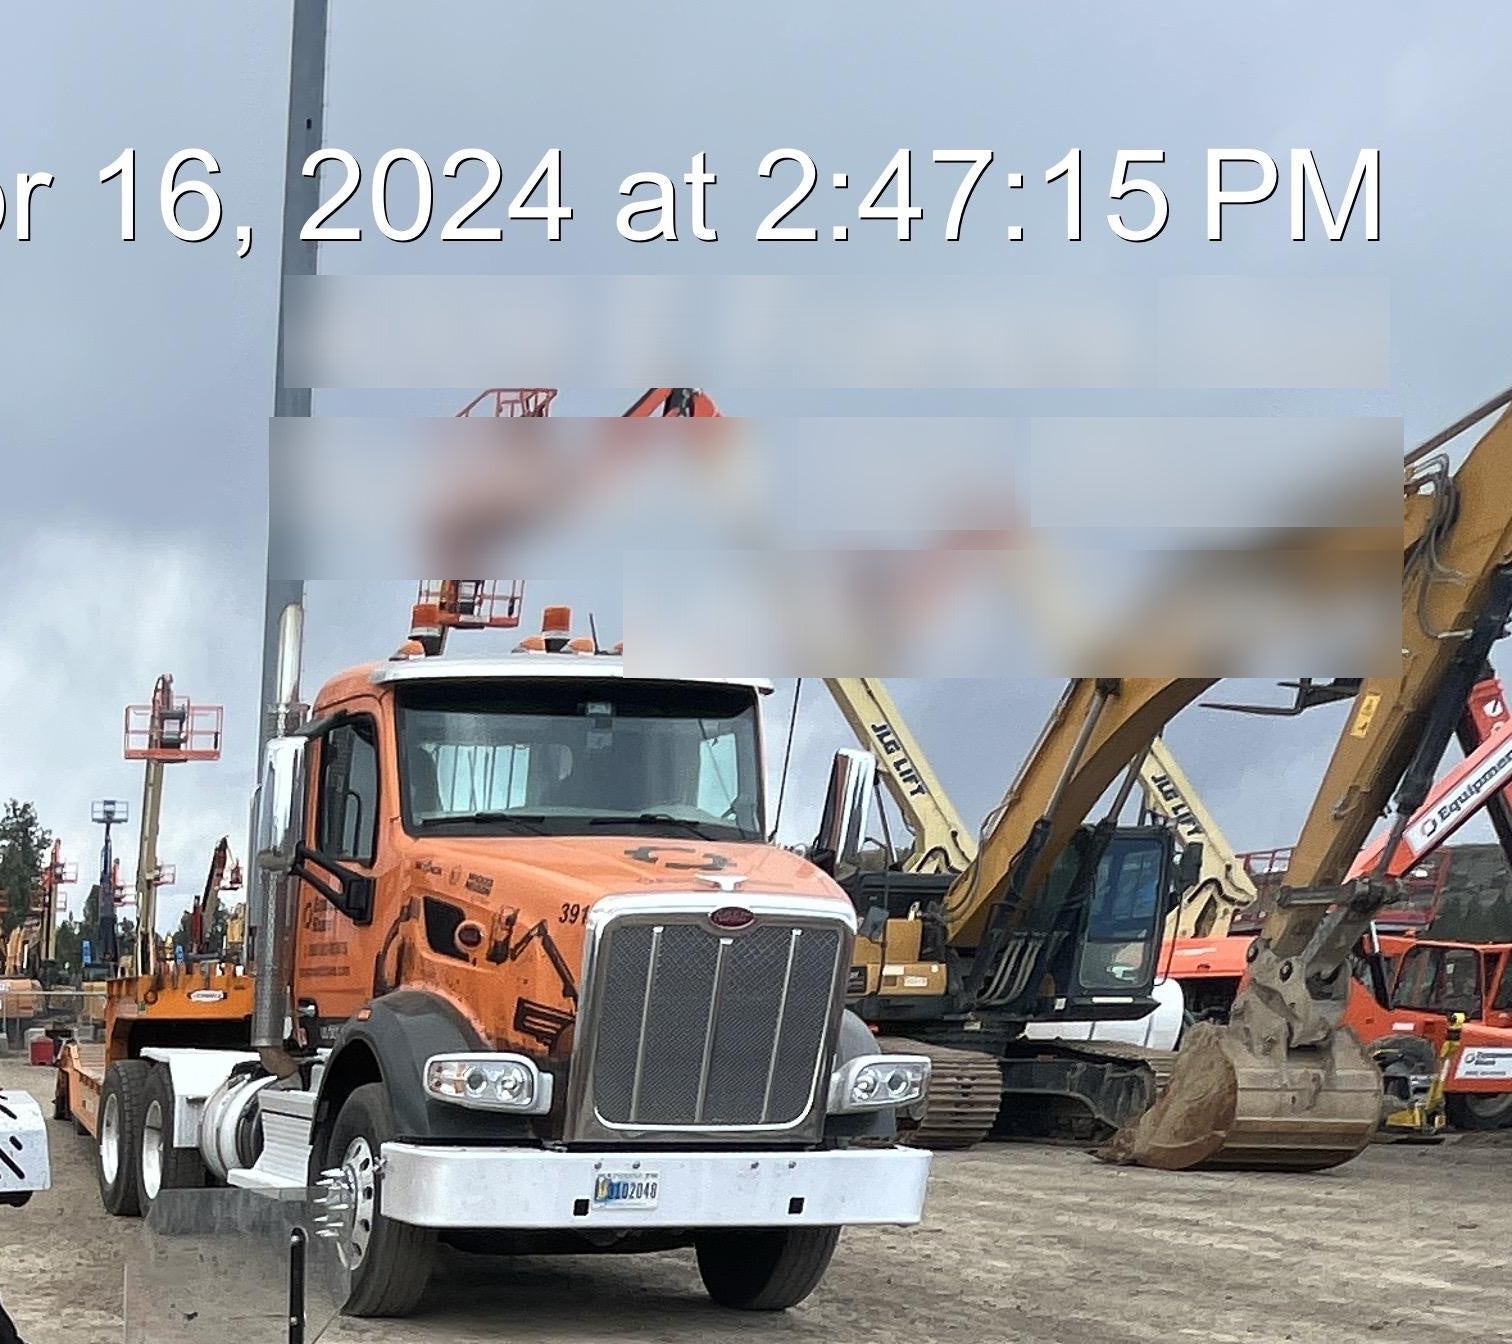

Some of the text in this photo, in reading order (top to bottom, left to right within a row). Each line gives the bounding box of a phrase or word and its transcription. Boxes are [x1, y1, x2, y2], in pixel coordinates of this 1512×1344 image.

[871, 724, 926, 797] JLG LIFT
[1151, 775, 1204, 836] JLG LIFT
